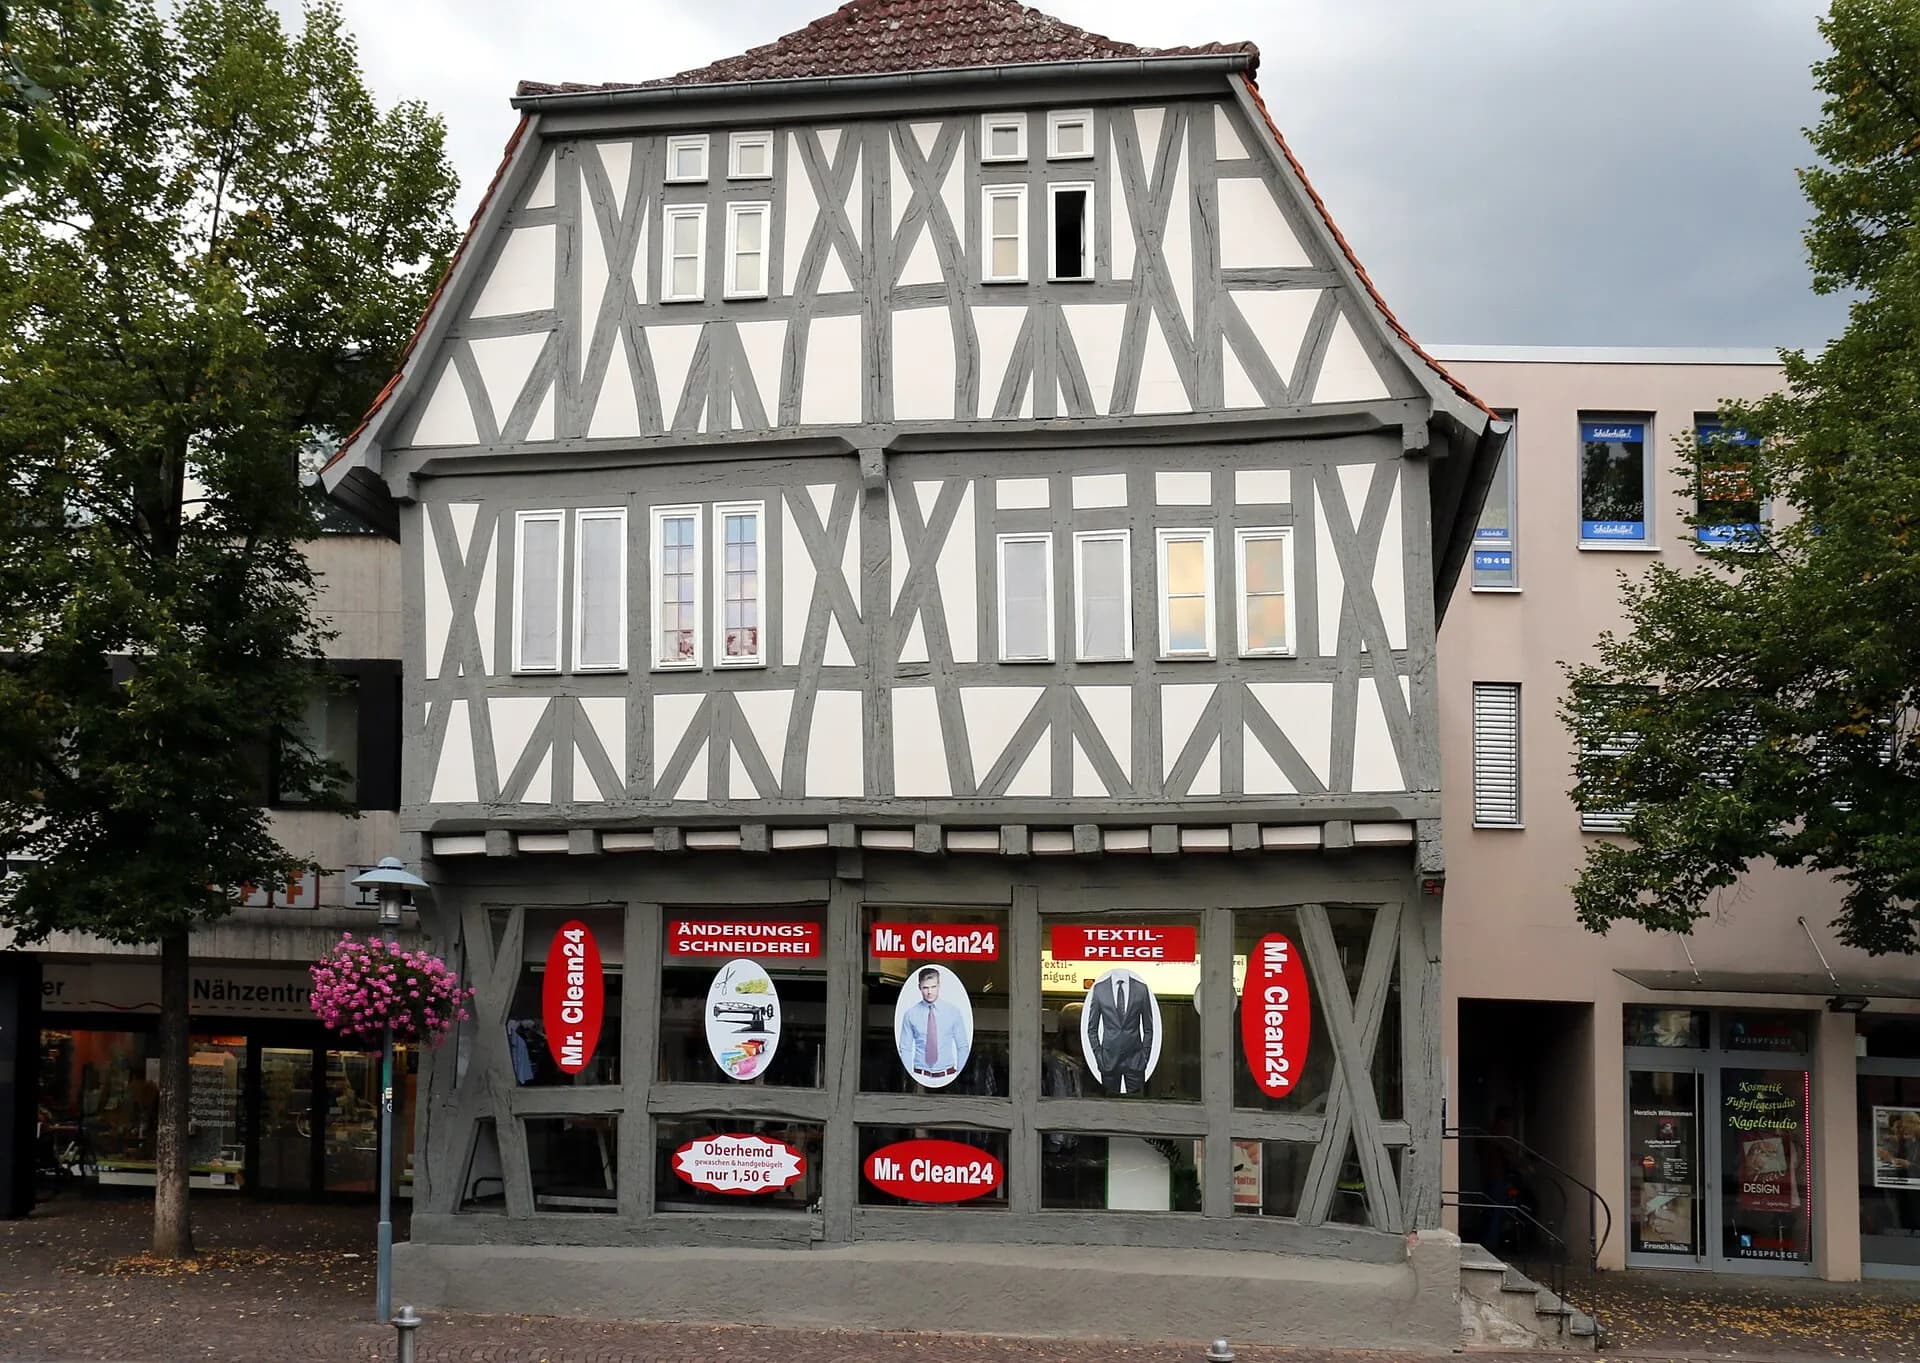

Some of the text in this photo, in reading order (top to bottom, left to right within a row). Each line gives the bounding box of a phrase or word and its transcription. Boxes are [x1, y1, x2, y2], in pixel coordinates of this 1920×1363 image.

[677, 921, 812, 937] ÄNDERUNGS-
[1084, 929, 1164, 941] TEXTIL-
[678, 940, 810, 954] SCHNEIDEREI
[876, 929, 995, 953] Mr. Clean24
[1084, 946, 1164, 958] PFLEGE
[1042, 972, 1077, 983] nigung
[41, 980, 64, 996] er
[561, 928, 585, 1066] Mr. Clean24
[1263, 941, 1290, 1088] Mr. Clean24
[1738, 1081, 1784, 1096] Kosmetik
[1724, 1096, 1797, 1112] Fußpflegestudio
[1728, 1114, 1798, 1130] Nagelstudio
[704, 1143, 774, 1158] Oberhemd
[694, 1159, 730, 1167] gewaschen
[737, 1160, 783, 1169] handgebügelt
[875, 1158, 994, 1184] Mr. Clean24
[706, 1170, 771, 1183] nur 1,50 €
[1743, 1183, 1780, 1194] DESIGN
[1740, 1249, 1799, 1259] FUSSPFLEGE
